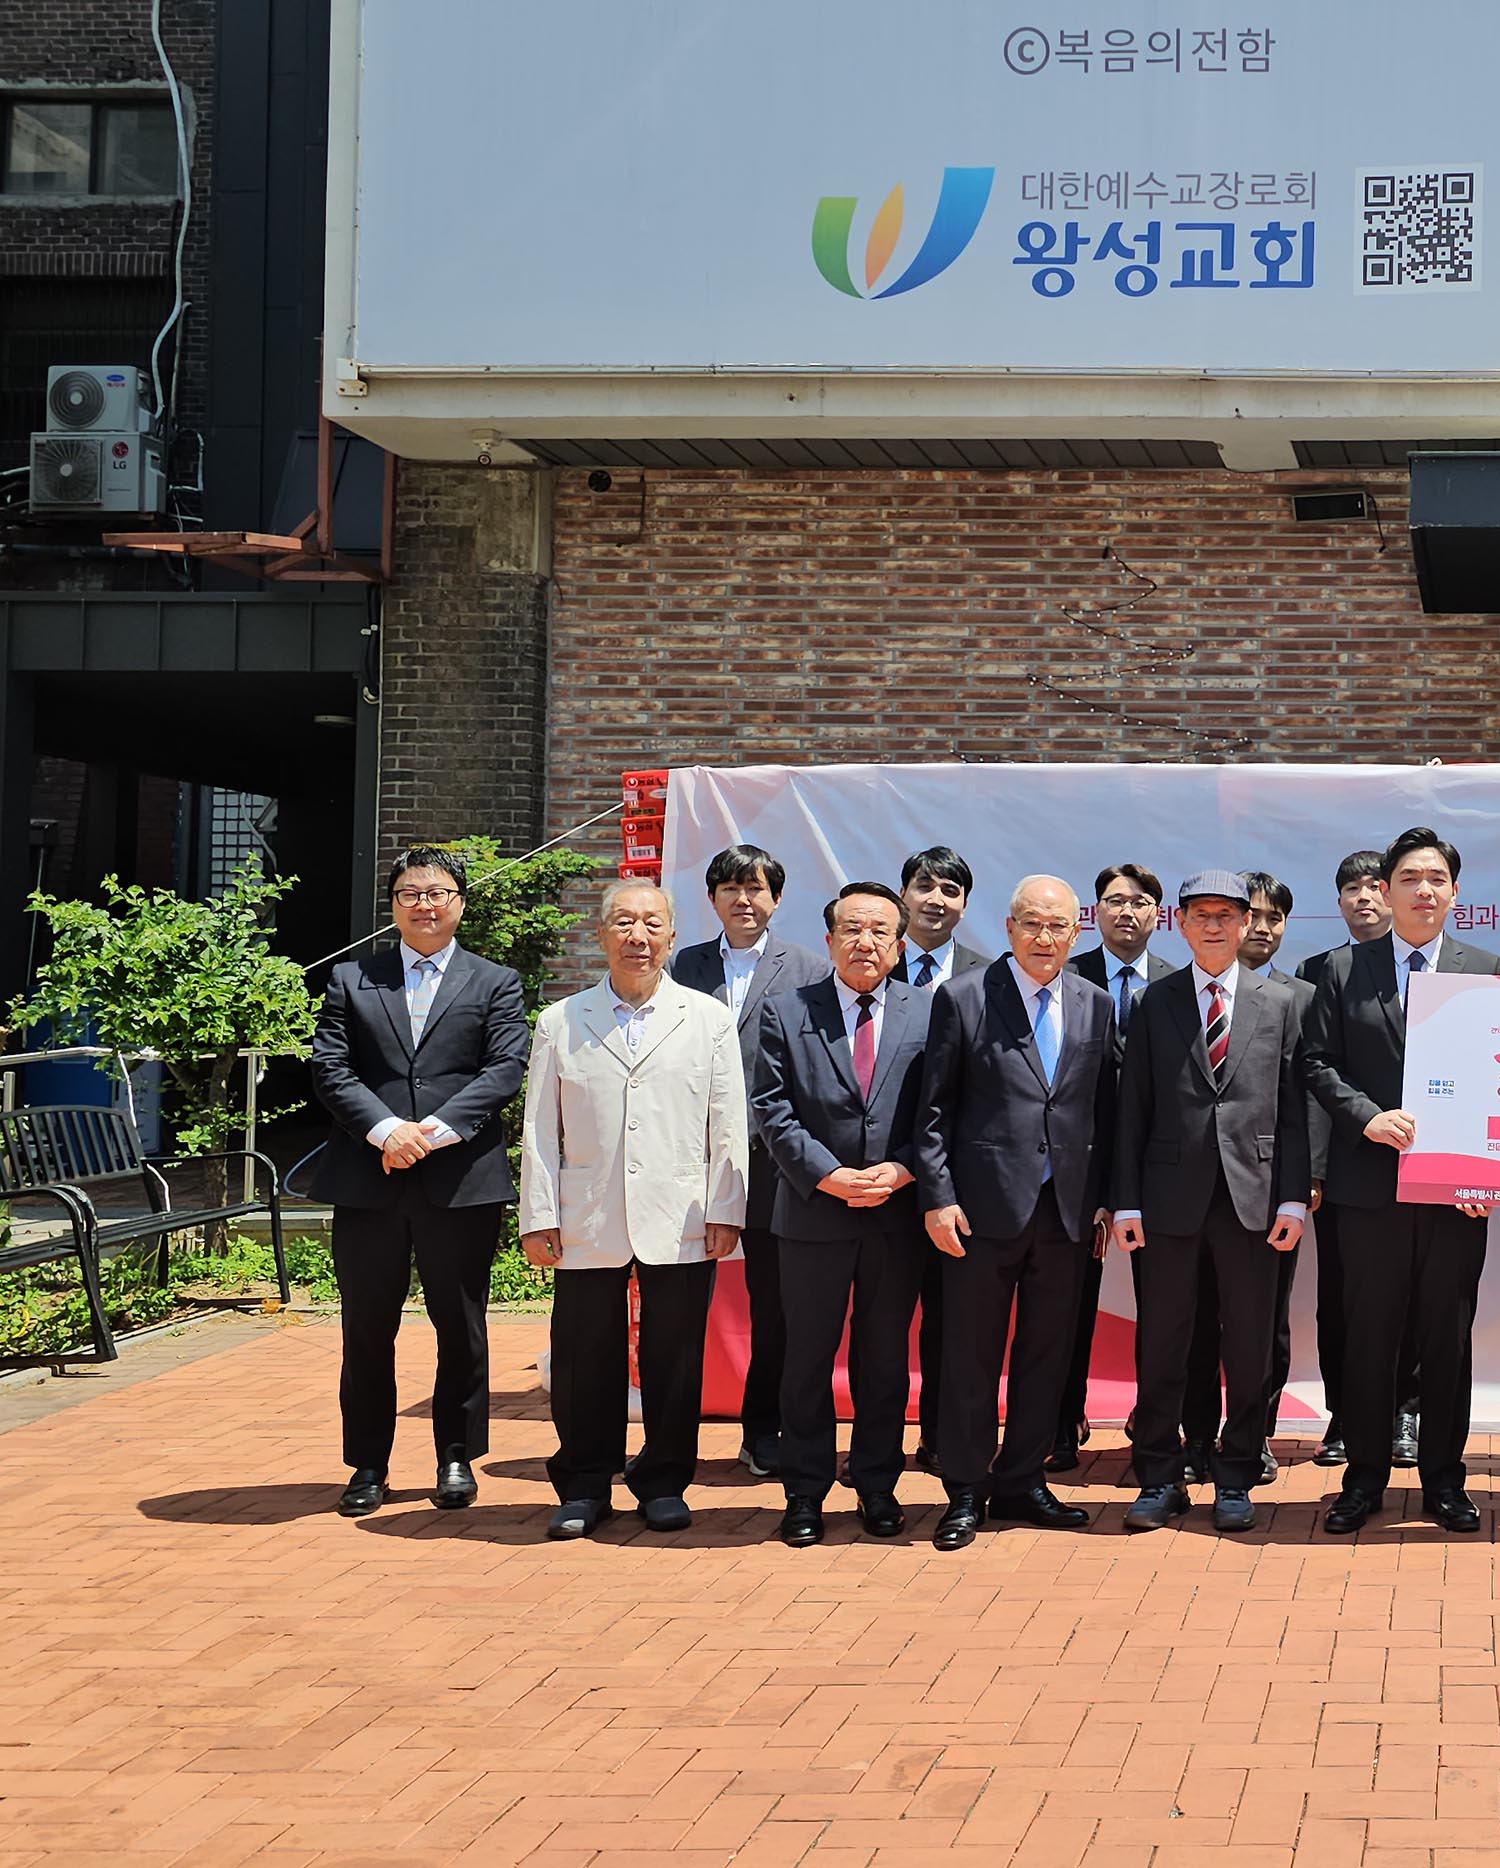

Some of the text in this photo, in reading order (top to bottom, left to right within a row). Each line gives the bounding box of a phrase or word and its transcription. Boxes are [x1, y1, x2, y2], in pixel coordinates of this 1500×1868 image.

[1021, 171, 1317, 210] 대한예수교장로회
[1012, 221, 1316, 298] 왕성교회
[113, 461, 127, 470] LG
[1453, 904, 1499, 930] 힘과
[1454, 1187, 1493, 1200] 서울특별시
